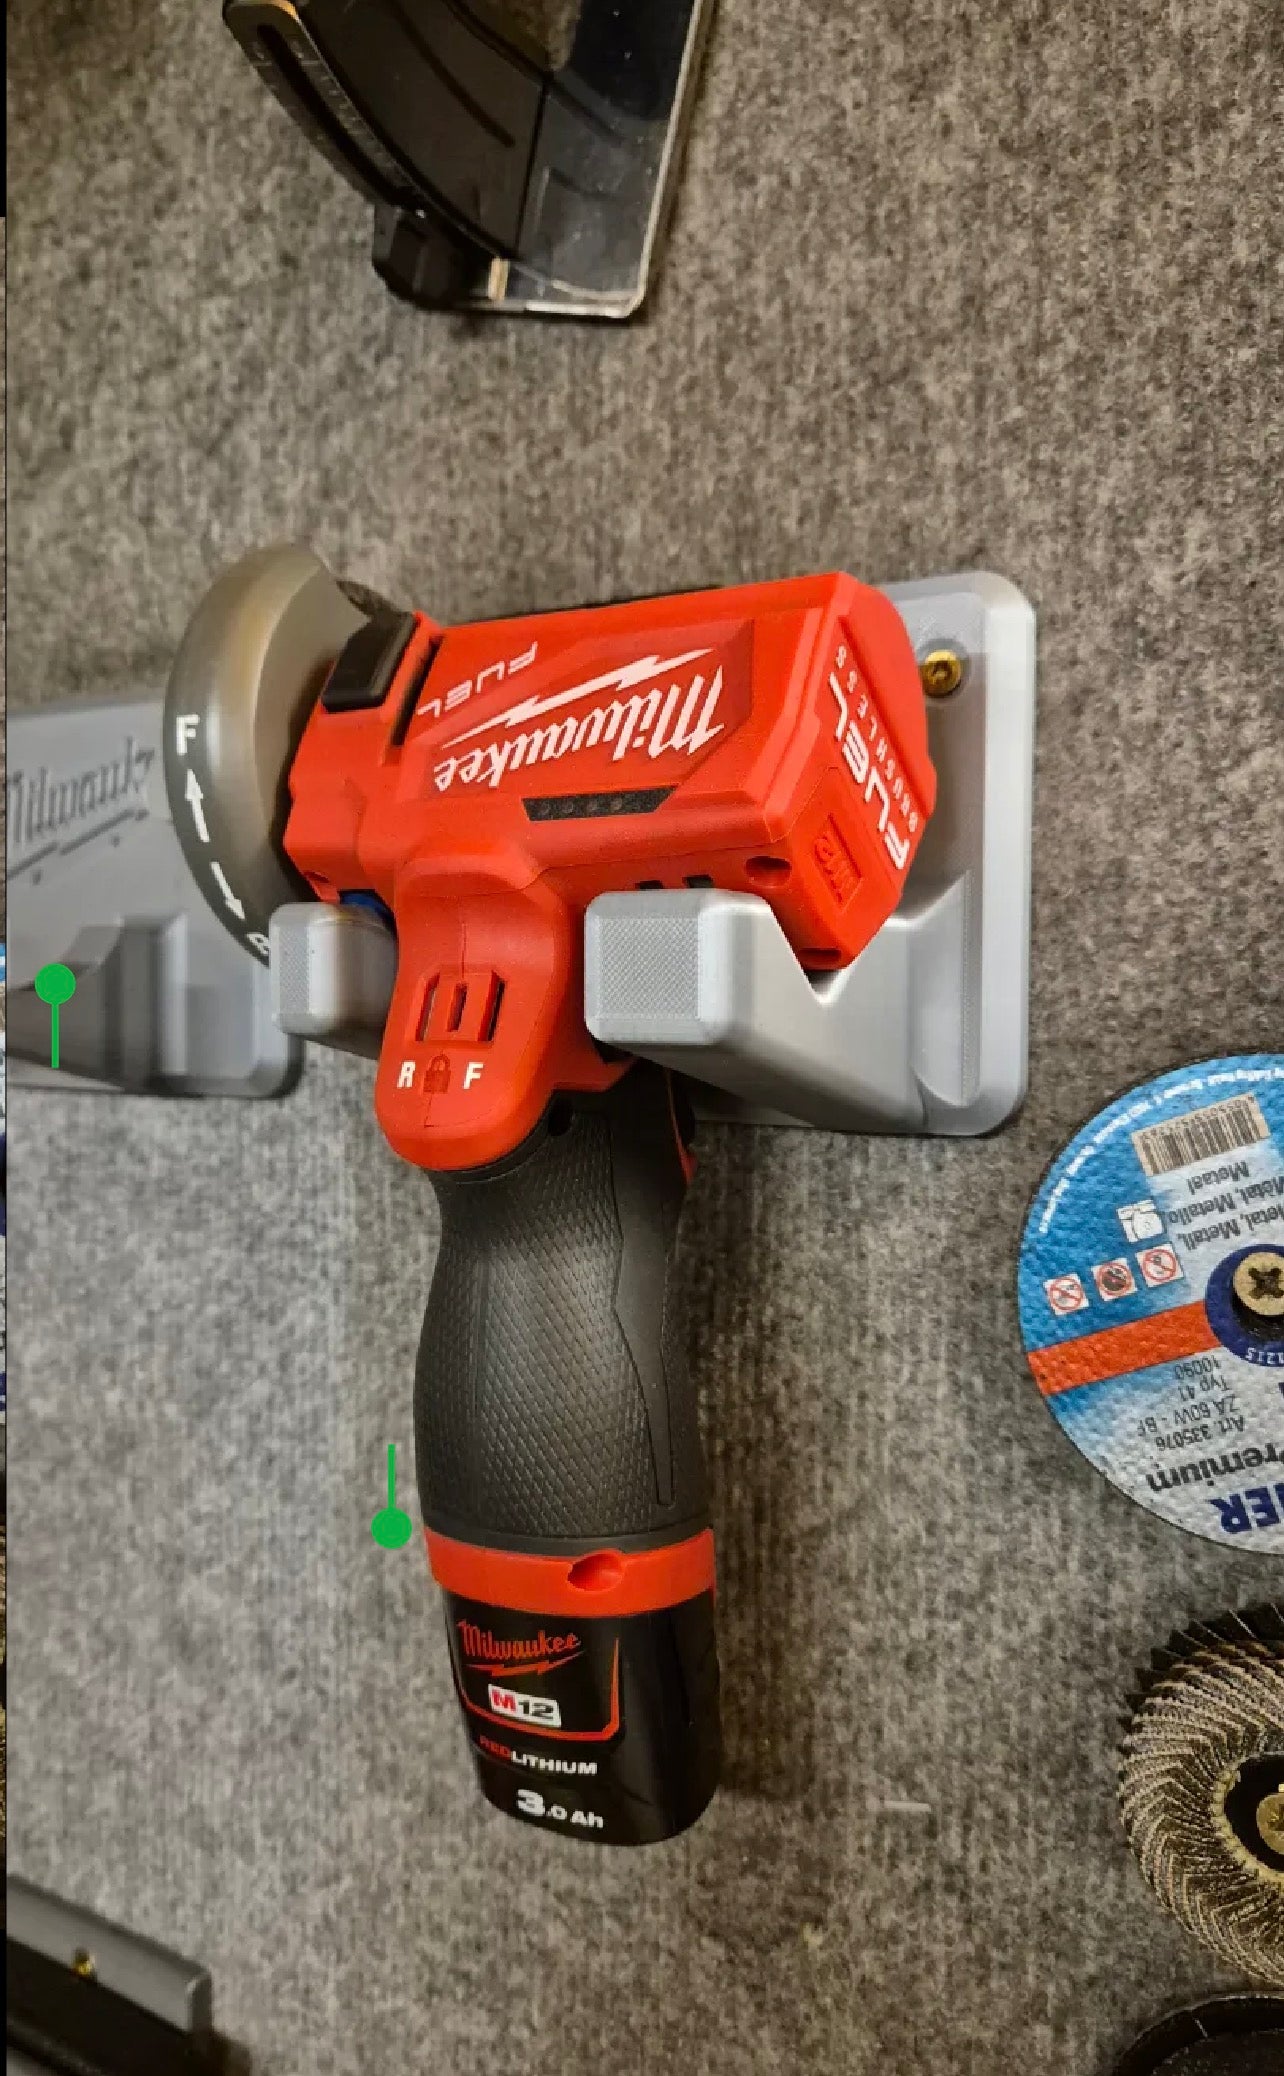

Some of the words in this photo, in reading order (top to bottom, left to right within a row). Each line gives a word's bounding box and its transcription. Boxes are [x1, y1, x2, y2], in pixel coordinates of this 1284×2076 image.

[417, 641, 538, 718] FUEL
[176, 713, 200, 757] F
[432, 665, 724, 792] Milwaukee
[836, 645, 918, 833] BRUSHLESS
[829, 672, 910, 870] FUEL
[397, 1060, 417, 1088] R
[463, 1062, 484, 1090] F
[1145, 1443, 1284, 1492] remium
[456, 1620, 581, 1660] Milwaukee
[490, 1689, 555, 1720] M12
[478, 1735, 598, 1775] REDLITHIUM
[516, 1789, 567, 1821] 3.0
[569, 1810, 604, 1829] Ah
